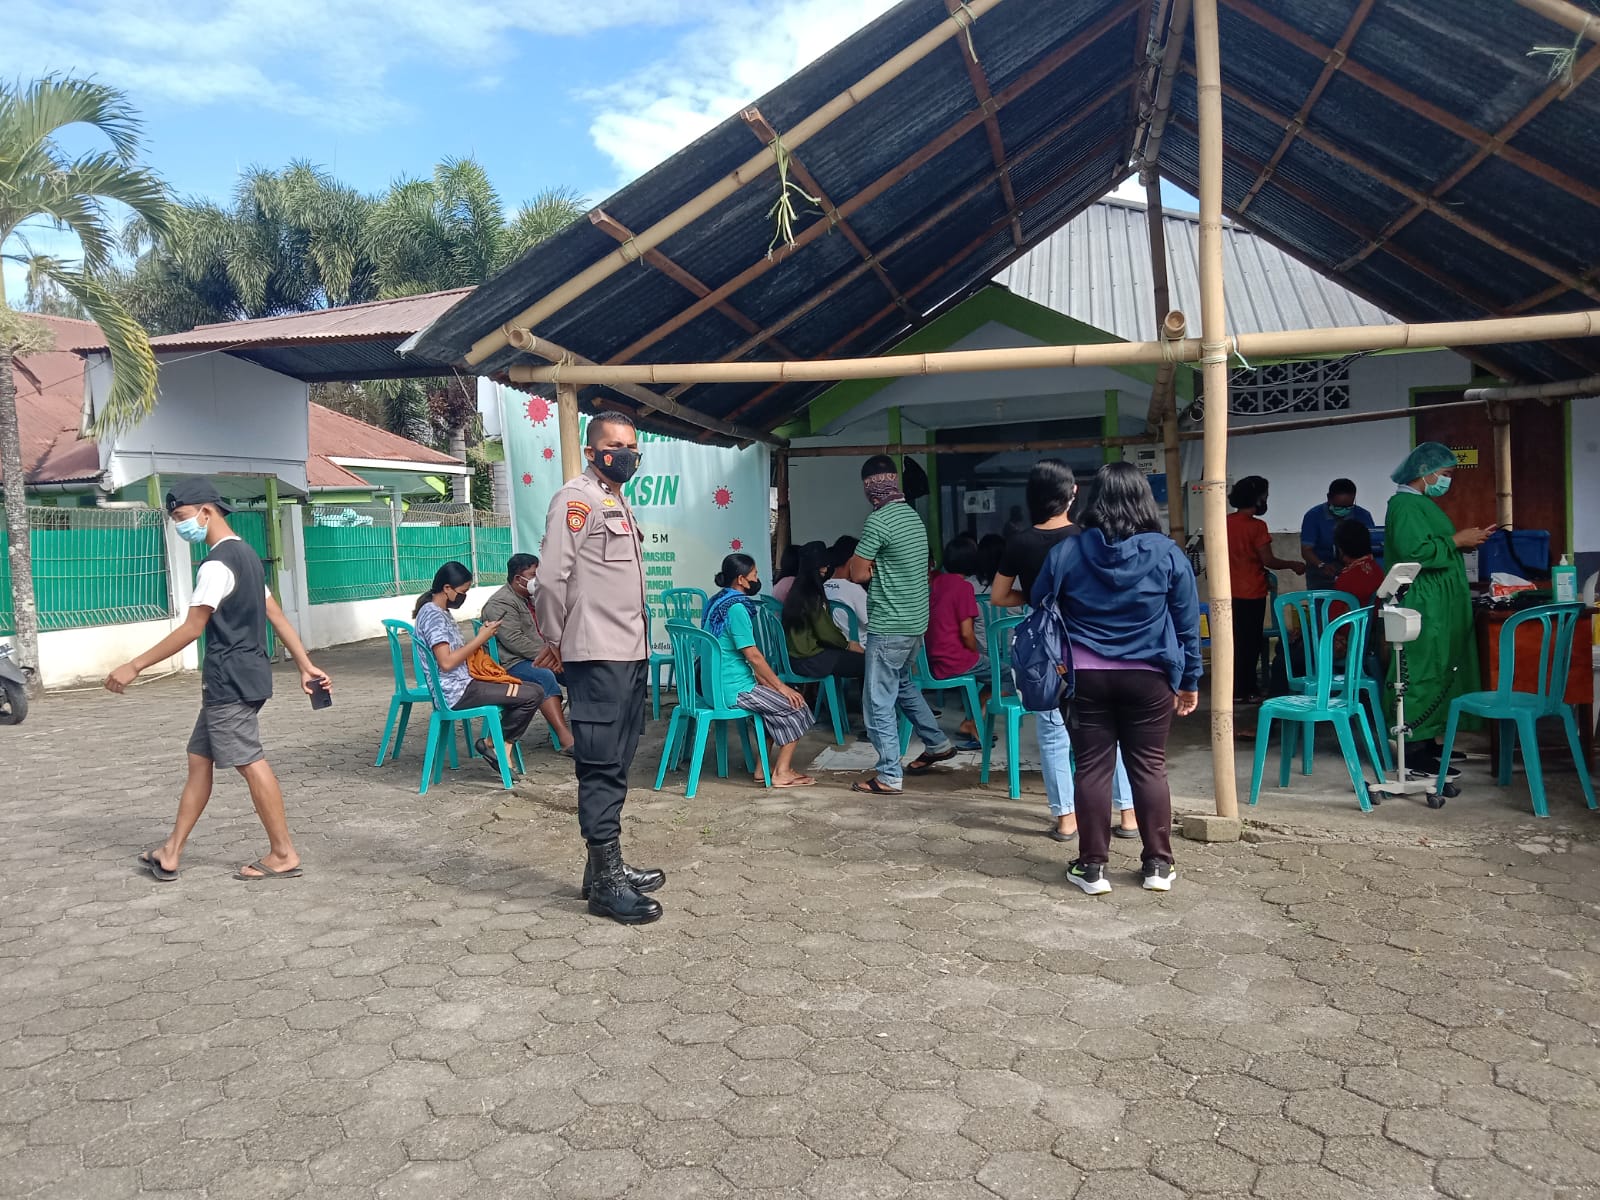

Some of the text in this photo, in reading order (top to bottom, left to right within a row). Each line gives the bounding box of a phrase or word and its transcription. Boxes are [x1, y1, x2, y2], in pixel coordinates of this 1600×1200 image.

[623, 475, 680, 507] KSIN
[652, 533, 669, 543] 5 M
[643, 552, 675, 562] MASKER
[646, 566, 672, 576] JARAK
